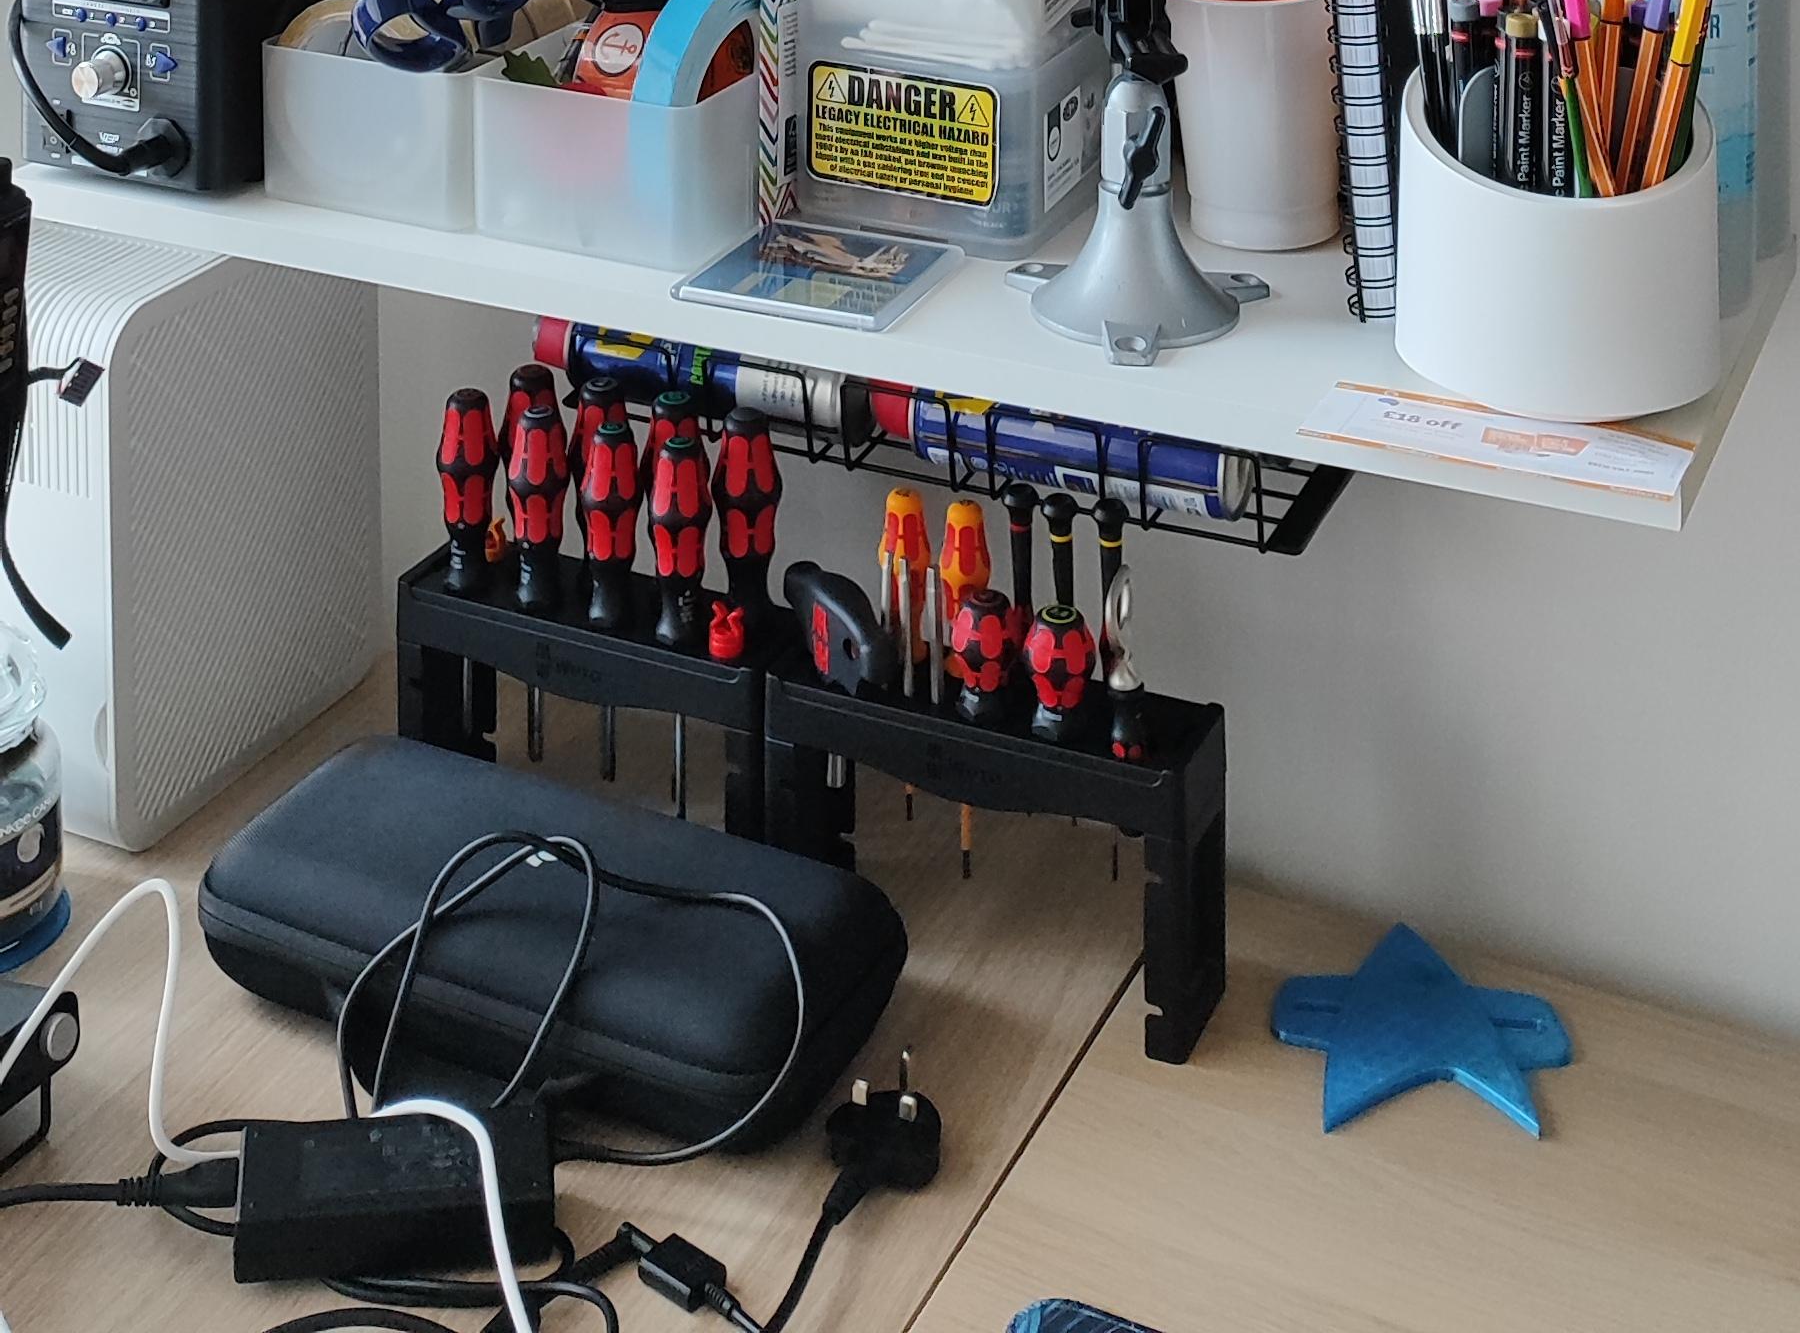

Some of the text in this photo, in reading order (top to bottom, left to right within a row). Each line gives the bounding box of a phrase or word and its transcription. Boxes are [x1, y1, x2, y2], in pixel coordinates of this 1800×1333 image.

[847, 74, 956, 123] DANGER
[815, 104, 989, 147] LEGACY ELECTRICAL HAZARD
[1518, 94, 1532, 182] Paint Marker
[1551, 99, 1566, 187] Paint Marker
[1383, 411, 1464, 430] £18 off
